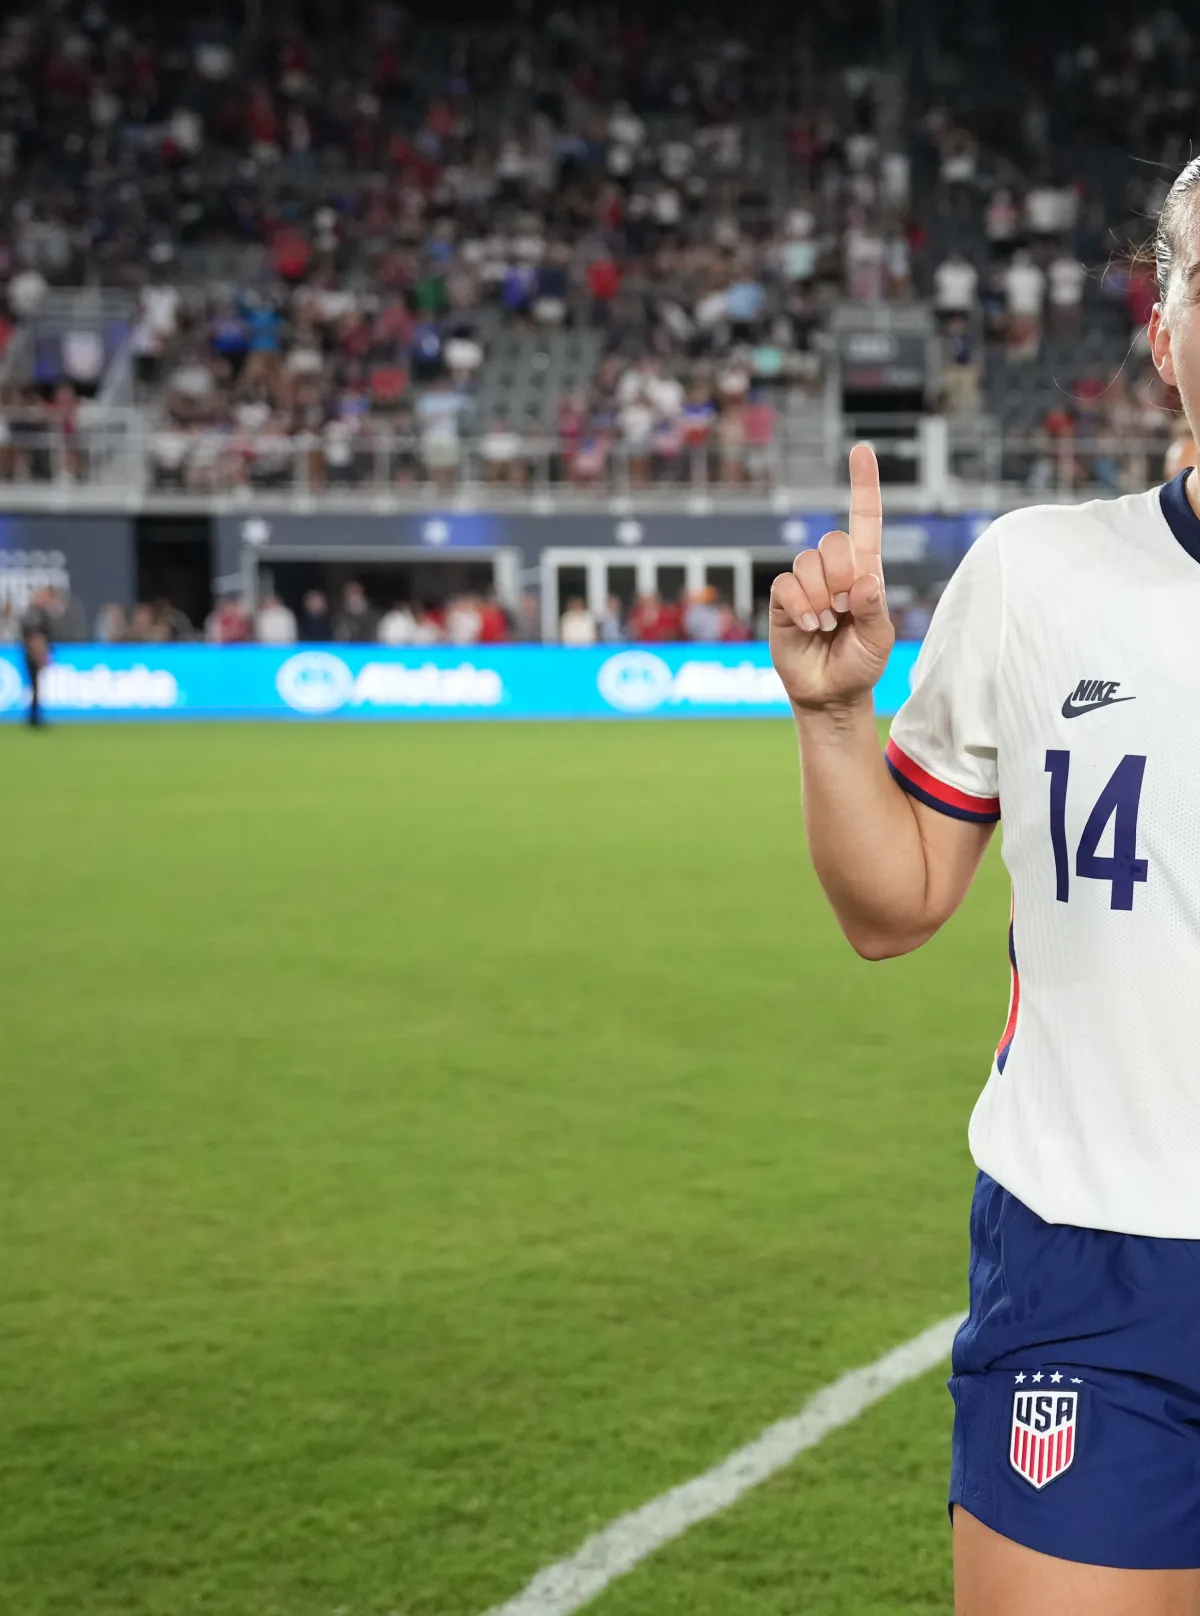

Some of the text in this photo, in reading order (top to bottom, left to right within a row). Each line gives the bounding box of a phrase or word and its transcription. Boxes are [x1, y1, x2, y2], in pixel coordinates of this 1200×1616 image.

[1072, 680, 1121, 703] NIKE
[1044, 749, 1149, 911] 14
[1015, 1396, 1074, 1434] USA
